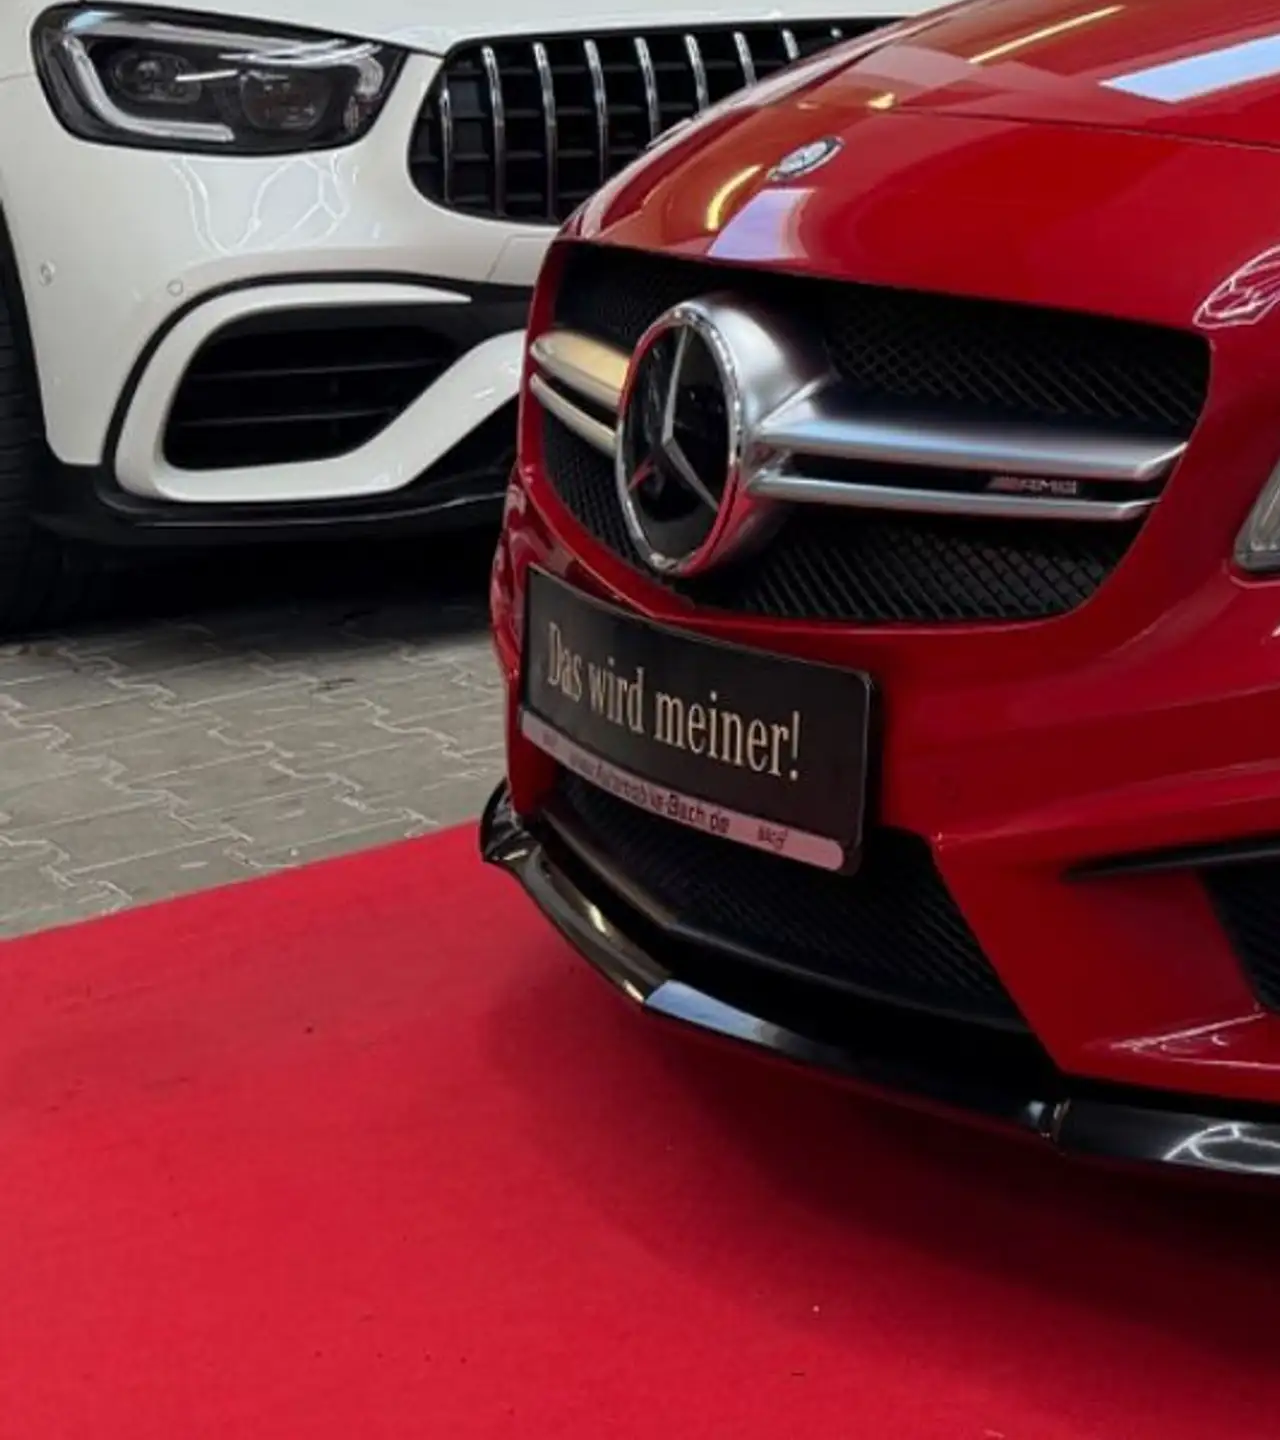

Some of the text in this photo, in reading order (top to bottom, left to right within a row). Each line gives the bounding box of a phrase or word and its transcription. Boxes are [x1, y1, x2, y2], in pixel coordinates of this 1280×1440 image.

[547, 621, 583, 703] Das
[587, 656, 645, 734] wird
[654, 690, 800, 781] meiner!
